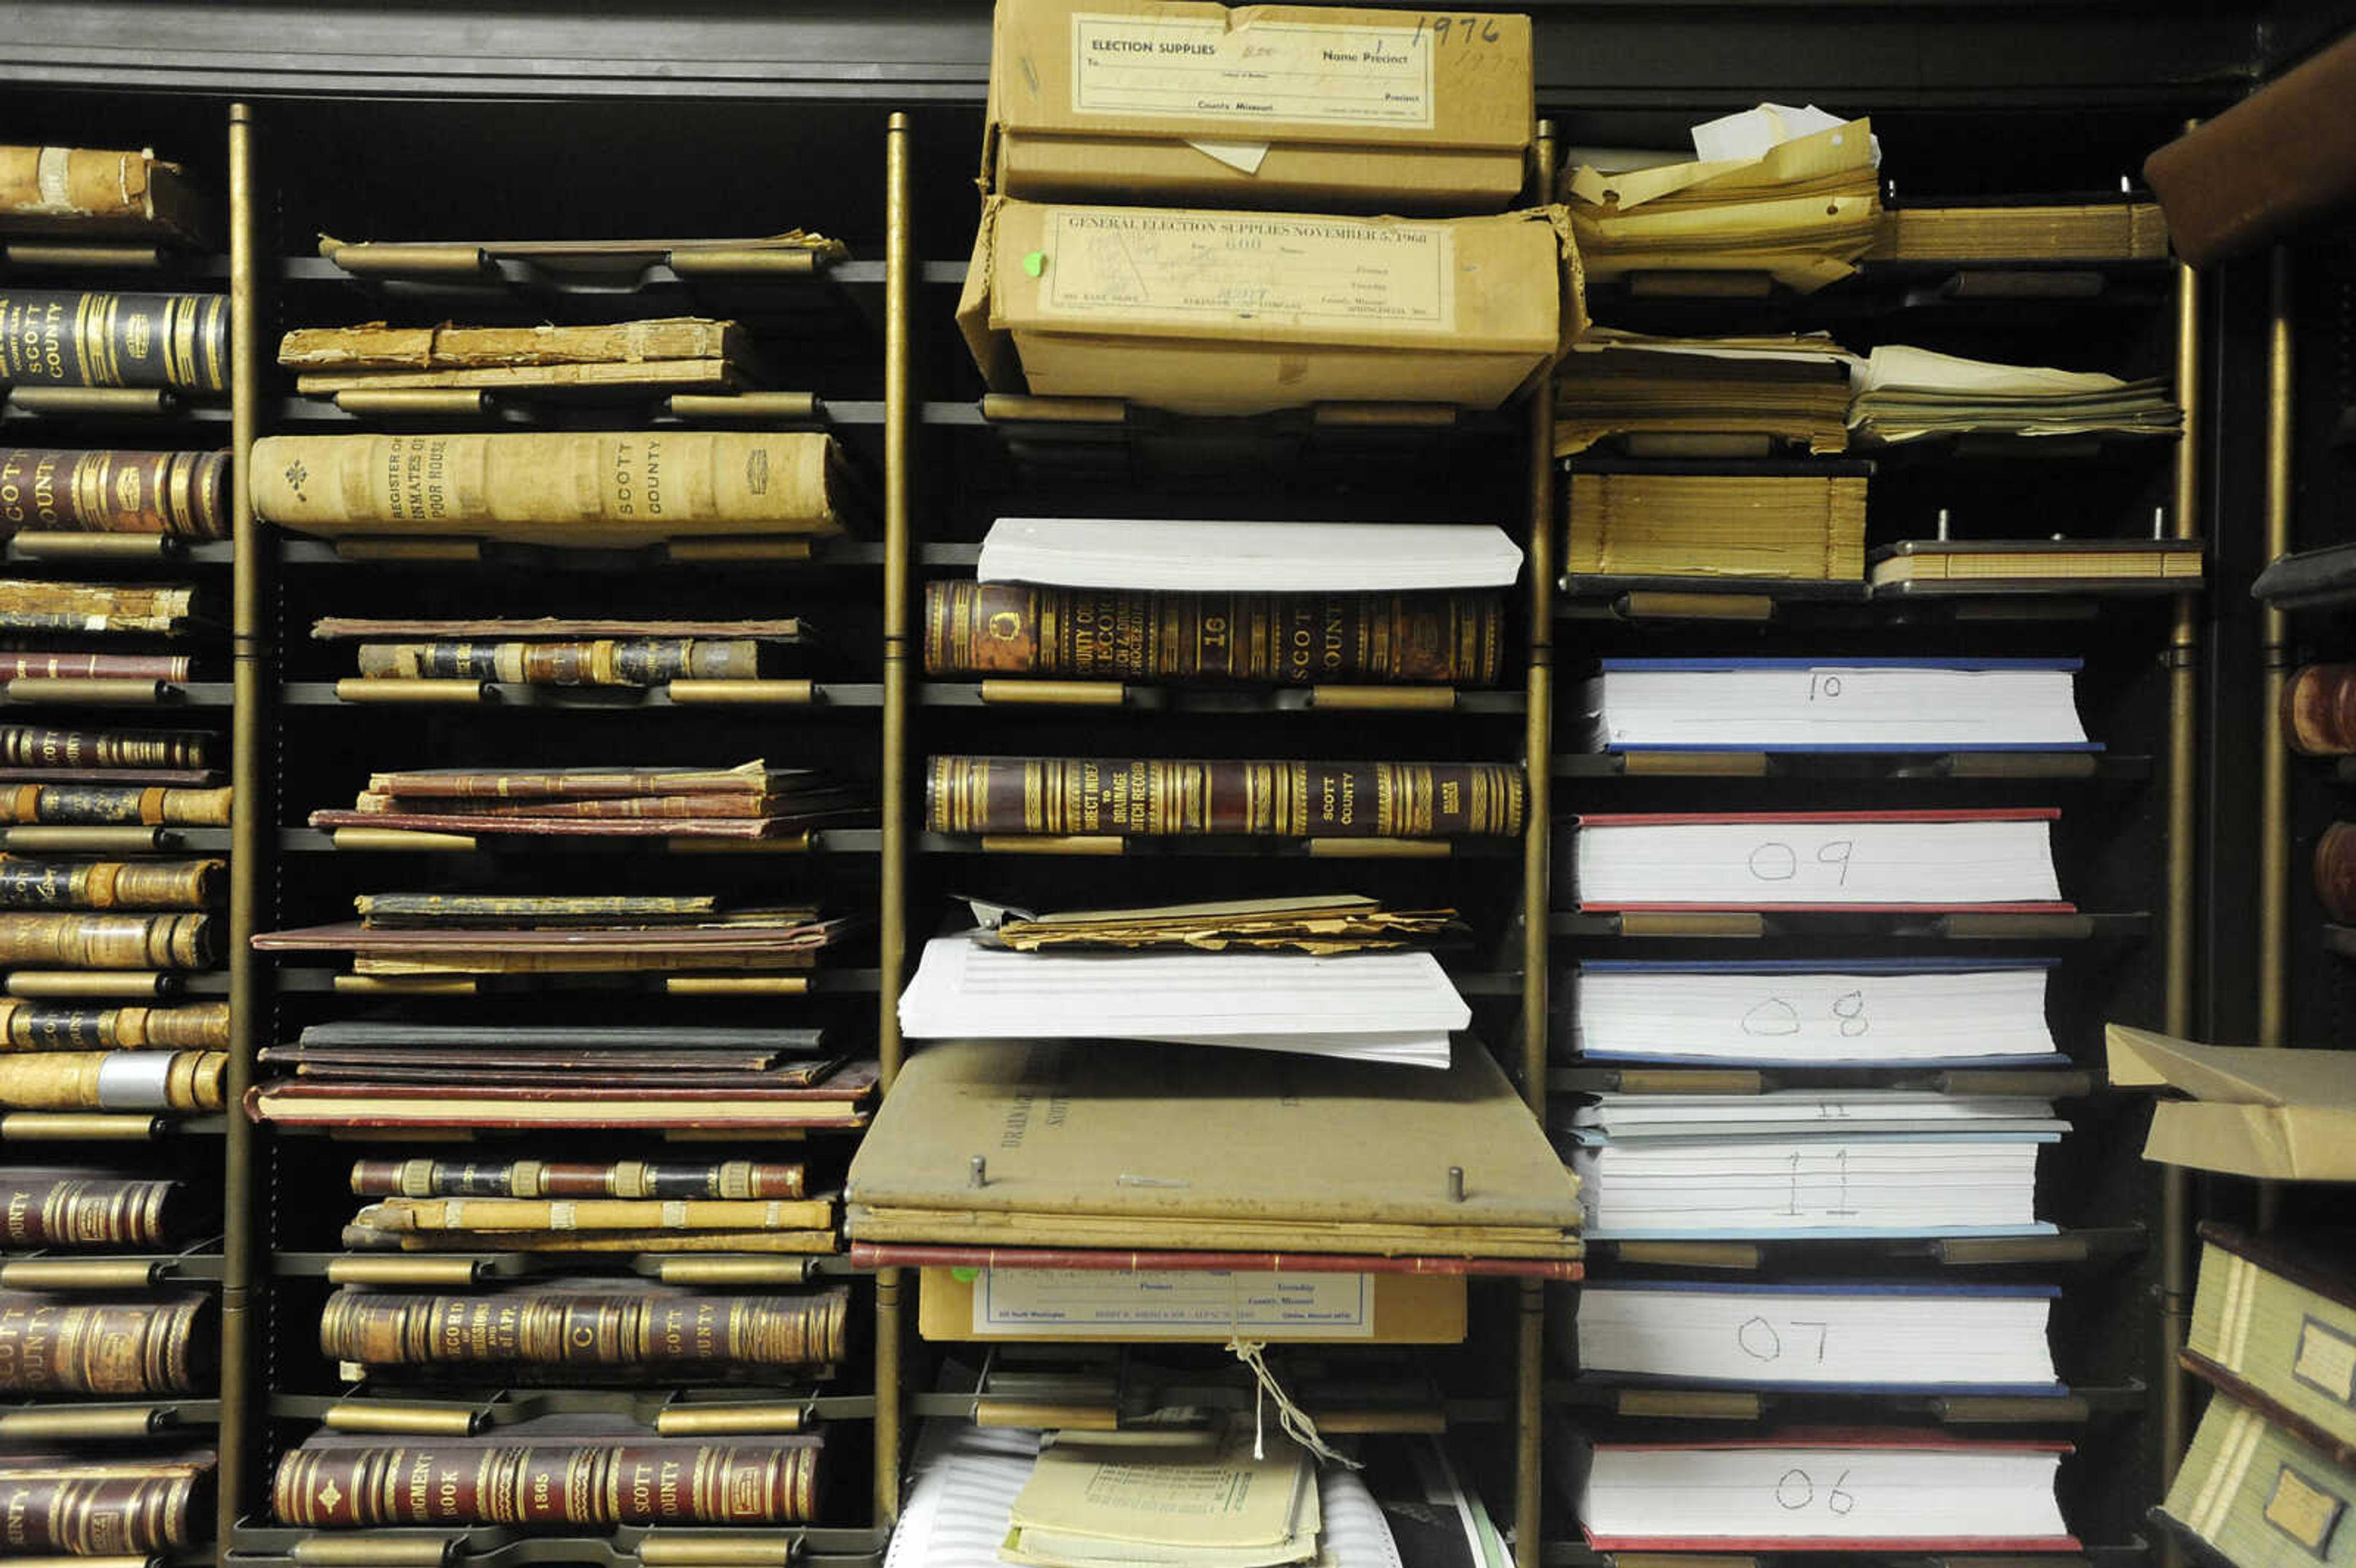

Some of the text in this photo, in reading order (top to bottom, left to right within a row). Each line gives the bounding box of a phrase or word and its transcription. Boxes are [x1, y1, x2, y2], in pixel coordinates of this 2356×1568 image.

[1091, 39, 1215, 55] ELECTION SUPPLIES
[1412, 17, 1501, 47] 1976
[1323, 50, 1409, 65] Name Precinct
[1069, 217, 1138, 231] GENERAL
[1142, 219, 1217, 233] ELECTION
[1220, 221, 1290, 237] SUPPLIES
[1295, 225, 1376, 242] NOVEMBER
[23, 304, 42, 374] SCOTT
[44, 302, 64, 379] COUNTY
[388, 454, 404, 519] REGISTER
[407, 455, 426, 519] INMATES
[429, 440, 447, 518] POOR HOUSE
[617, 442, 634, 515] SCOTT
[648, 440, 662, 515] COUNTY
[1809, 673, 1841, 701] 10
[1103, 790, 1112, 804] TO
[1113, 771, 1128, 824] DRAINAGE
[1322, 777, 1335, 821] SCOTT
[1340, 772, 1355, 826] COUNTY
[1749, 841, 1853, 886] 09
[572, 1326, 594, 1348] C
[1738, 1315, 1827, 1365] 07
[440, 1469, 458, 1517] BOOK
[634, 1462, 652, 1513] SCOTT
[1776, 1469, 1854, 1516] 06
